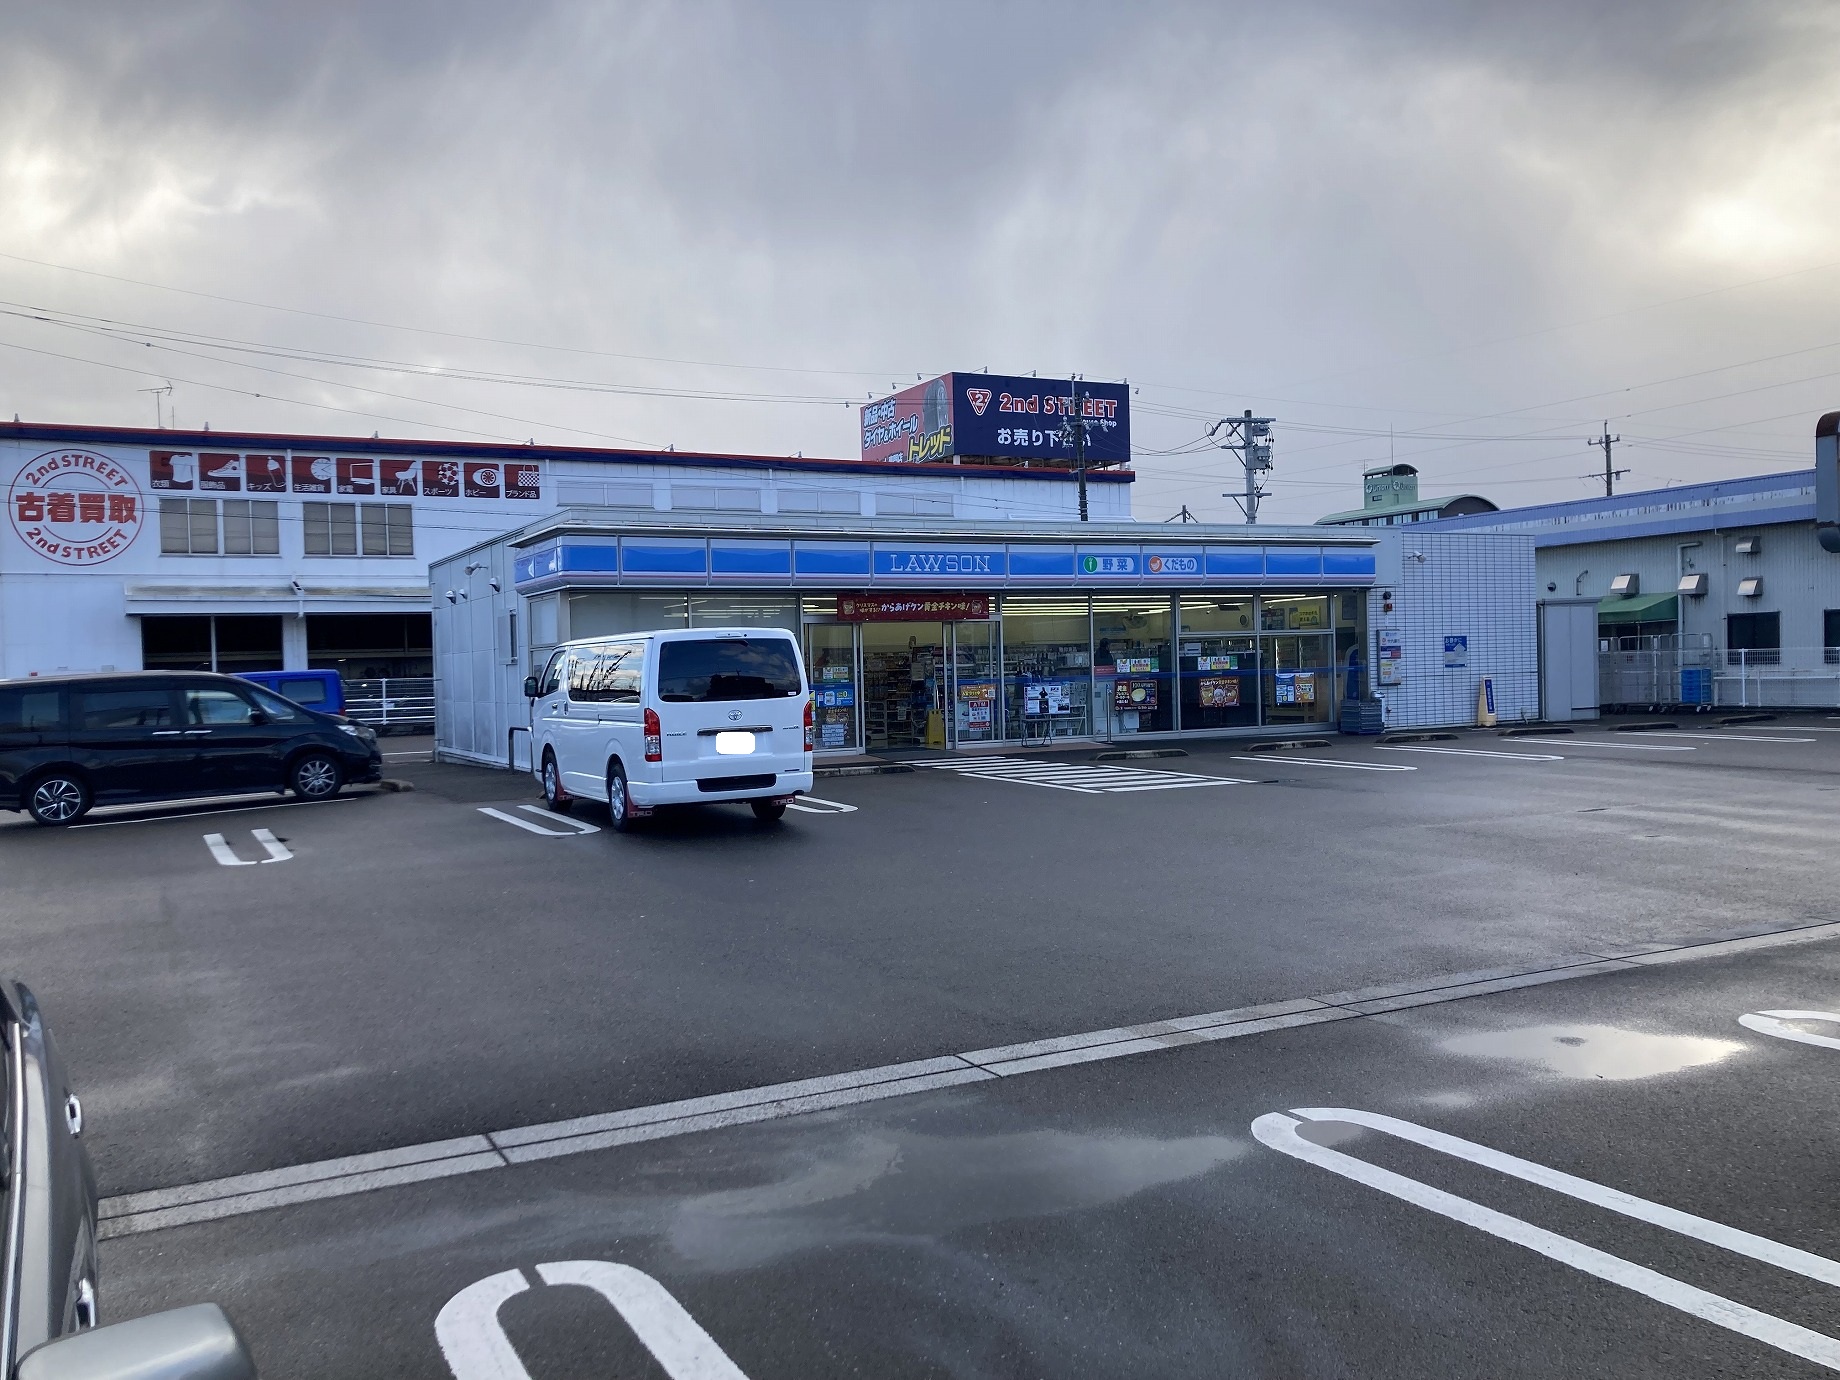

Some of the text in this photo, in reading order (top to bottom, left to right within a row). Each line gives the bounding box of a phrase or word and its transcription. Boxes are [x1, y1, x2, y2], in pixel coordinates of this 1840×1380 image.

[999, 392, 1039, 414] 2nd
[908, 426, 952, 461] トレッド
[25, 454, 128, 487] 2nd STREET
[247, 483, 272, 491] キッズ
[381, 486, 397, 494] 家具
[423, 487, 453, 496] スポーツ
[465, 489, 487, 497] ホビー
[505, 490, 537, 498] ブランド品
[16, 492, 136, 523] 古着買取
[26, 527, 127, 559] 2nd STREET
[890, 554, 990, 572] LAWSON
[1102, 558, 1128, 571] 野菜
[1164, 558, 1195, 571] くだもの
